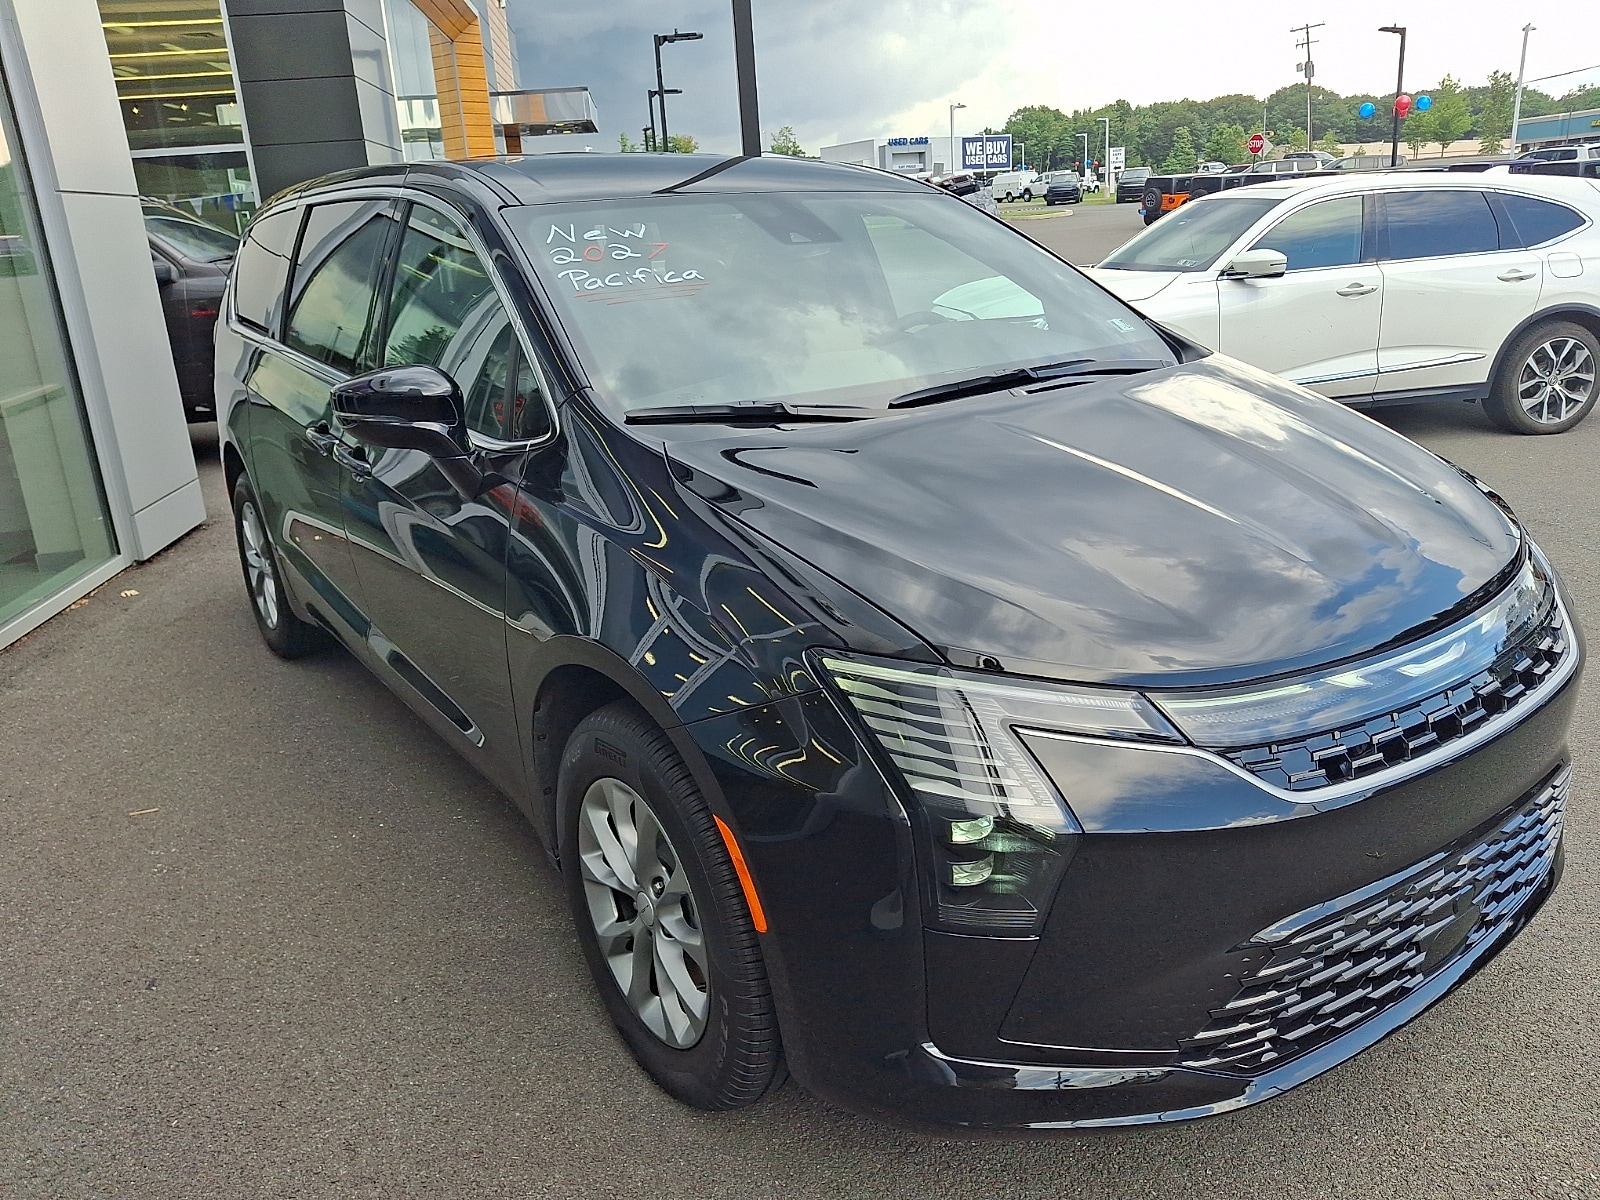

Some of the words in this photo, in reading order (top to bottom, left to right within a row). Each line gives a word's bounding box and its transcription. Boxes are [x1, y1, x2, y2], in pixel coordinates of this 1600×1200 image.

[888, 138, 908, 146] USED
[909, 137, 929, 145] CARS
[965, 141, 983, 155] WE
[986, 140, 1007, 154] BUY
[1249, 139, 1263, 149] STOP
[965, 155, 985, 165] USED
[987, 154, 1008, 164] CARS
[549, 242, 669, 265] 2027
[557, 267, 705, 291] Pacifica
[594, 737, 627, 768] PIRELLI
